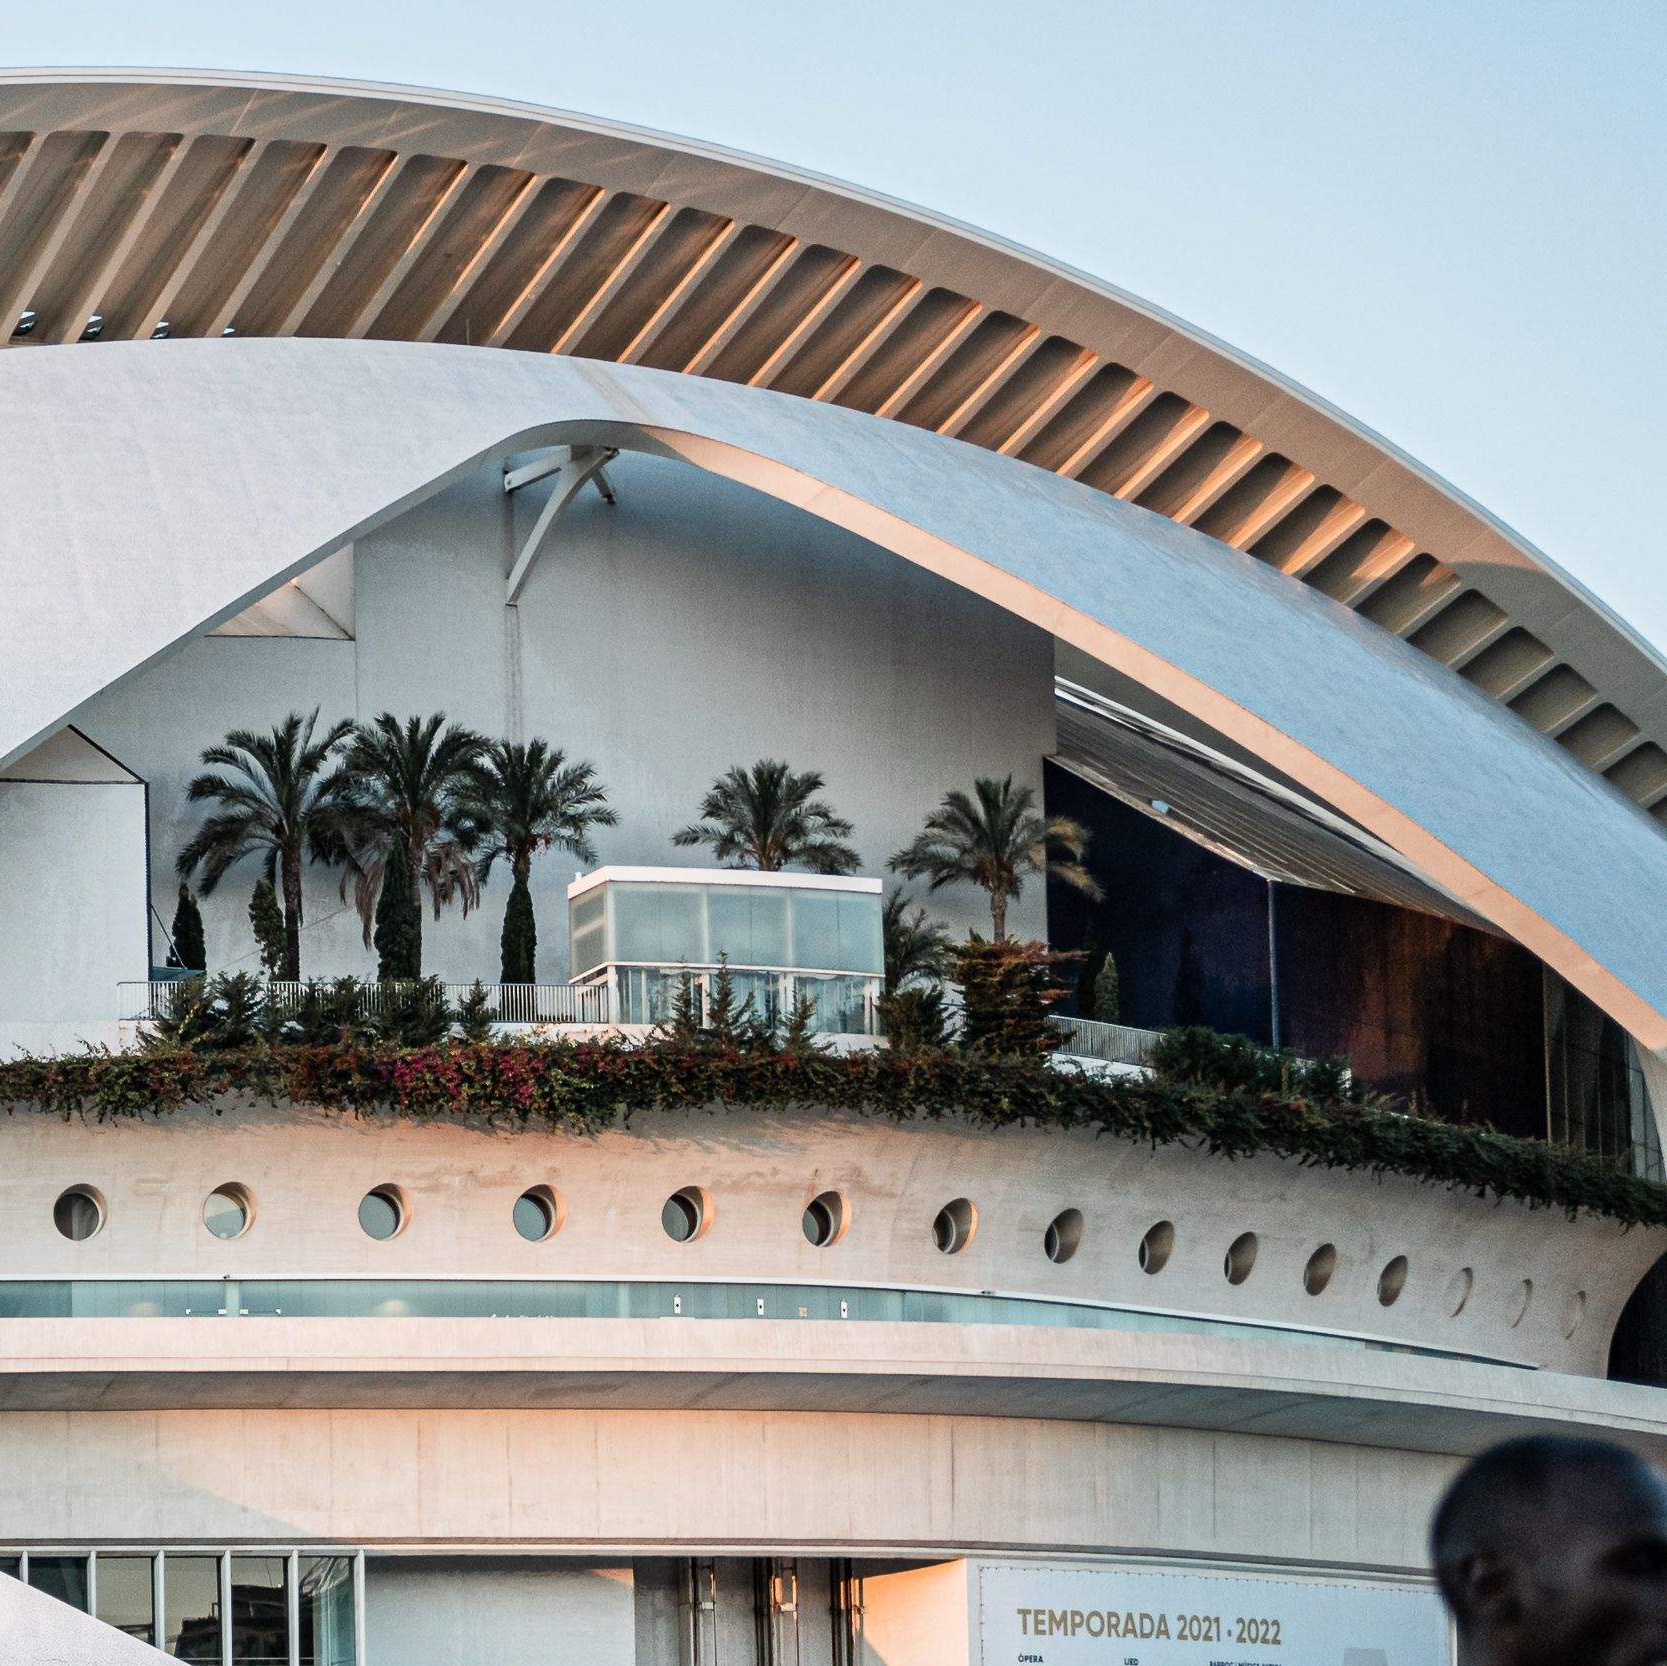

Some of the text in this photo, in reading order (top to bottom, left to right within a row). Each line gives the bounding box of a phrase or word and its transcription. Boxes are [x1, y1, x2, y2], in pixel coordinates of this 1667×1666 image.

[1017, 1608, 1171, 1640] TEMPORADA
[1177, 1613, 1221, 1642] 2021
[1235, 1617, 1282, 1646] 2022
